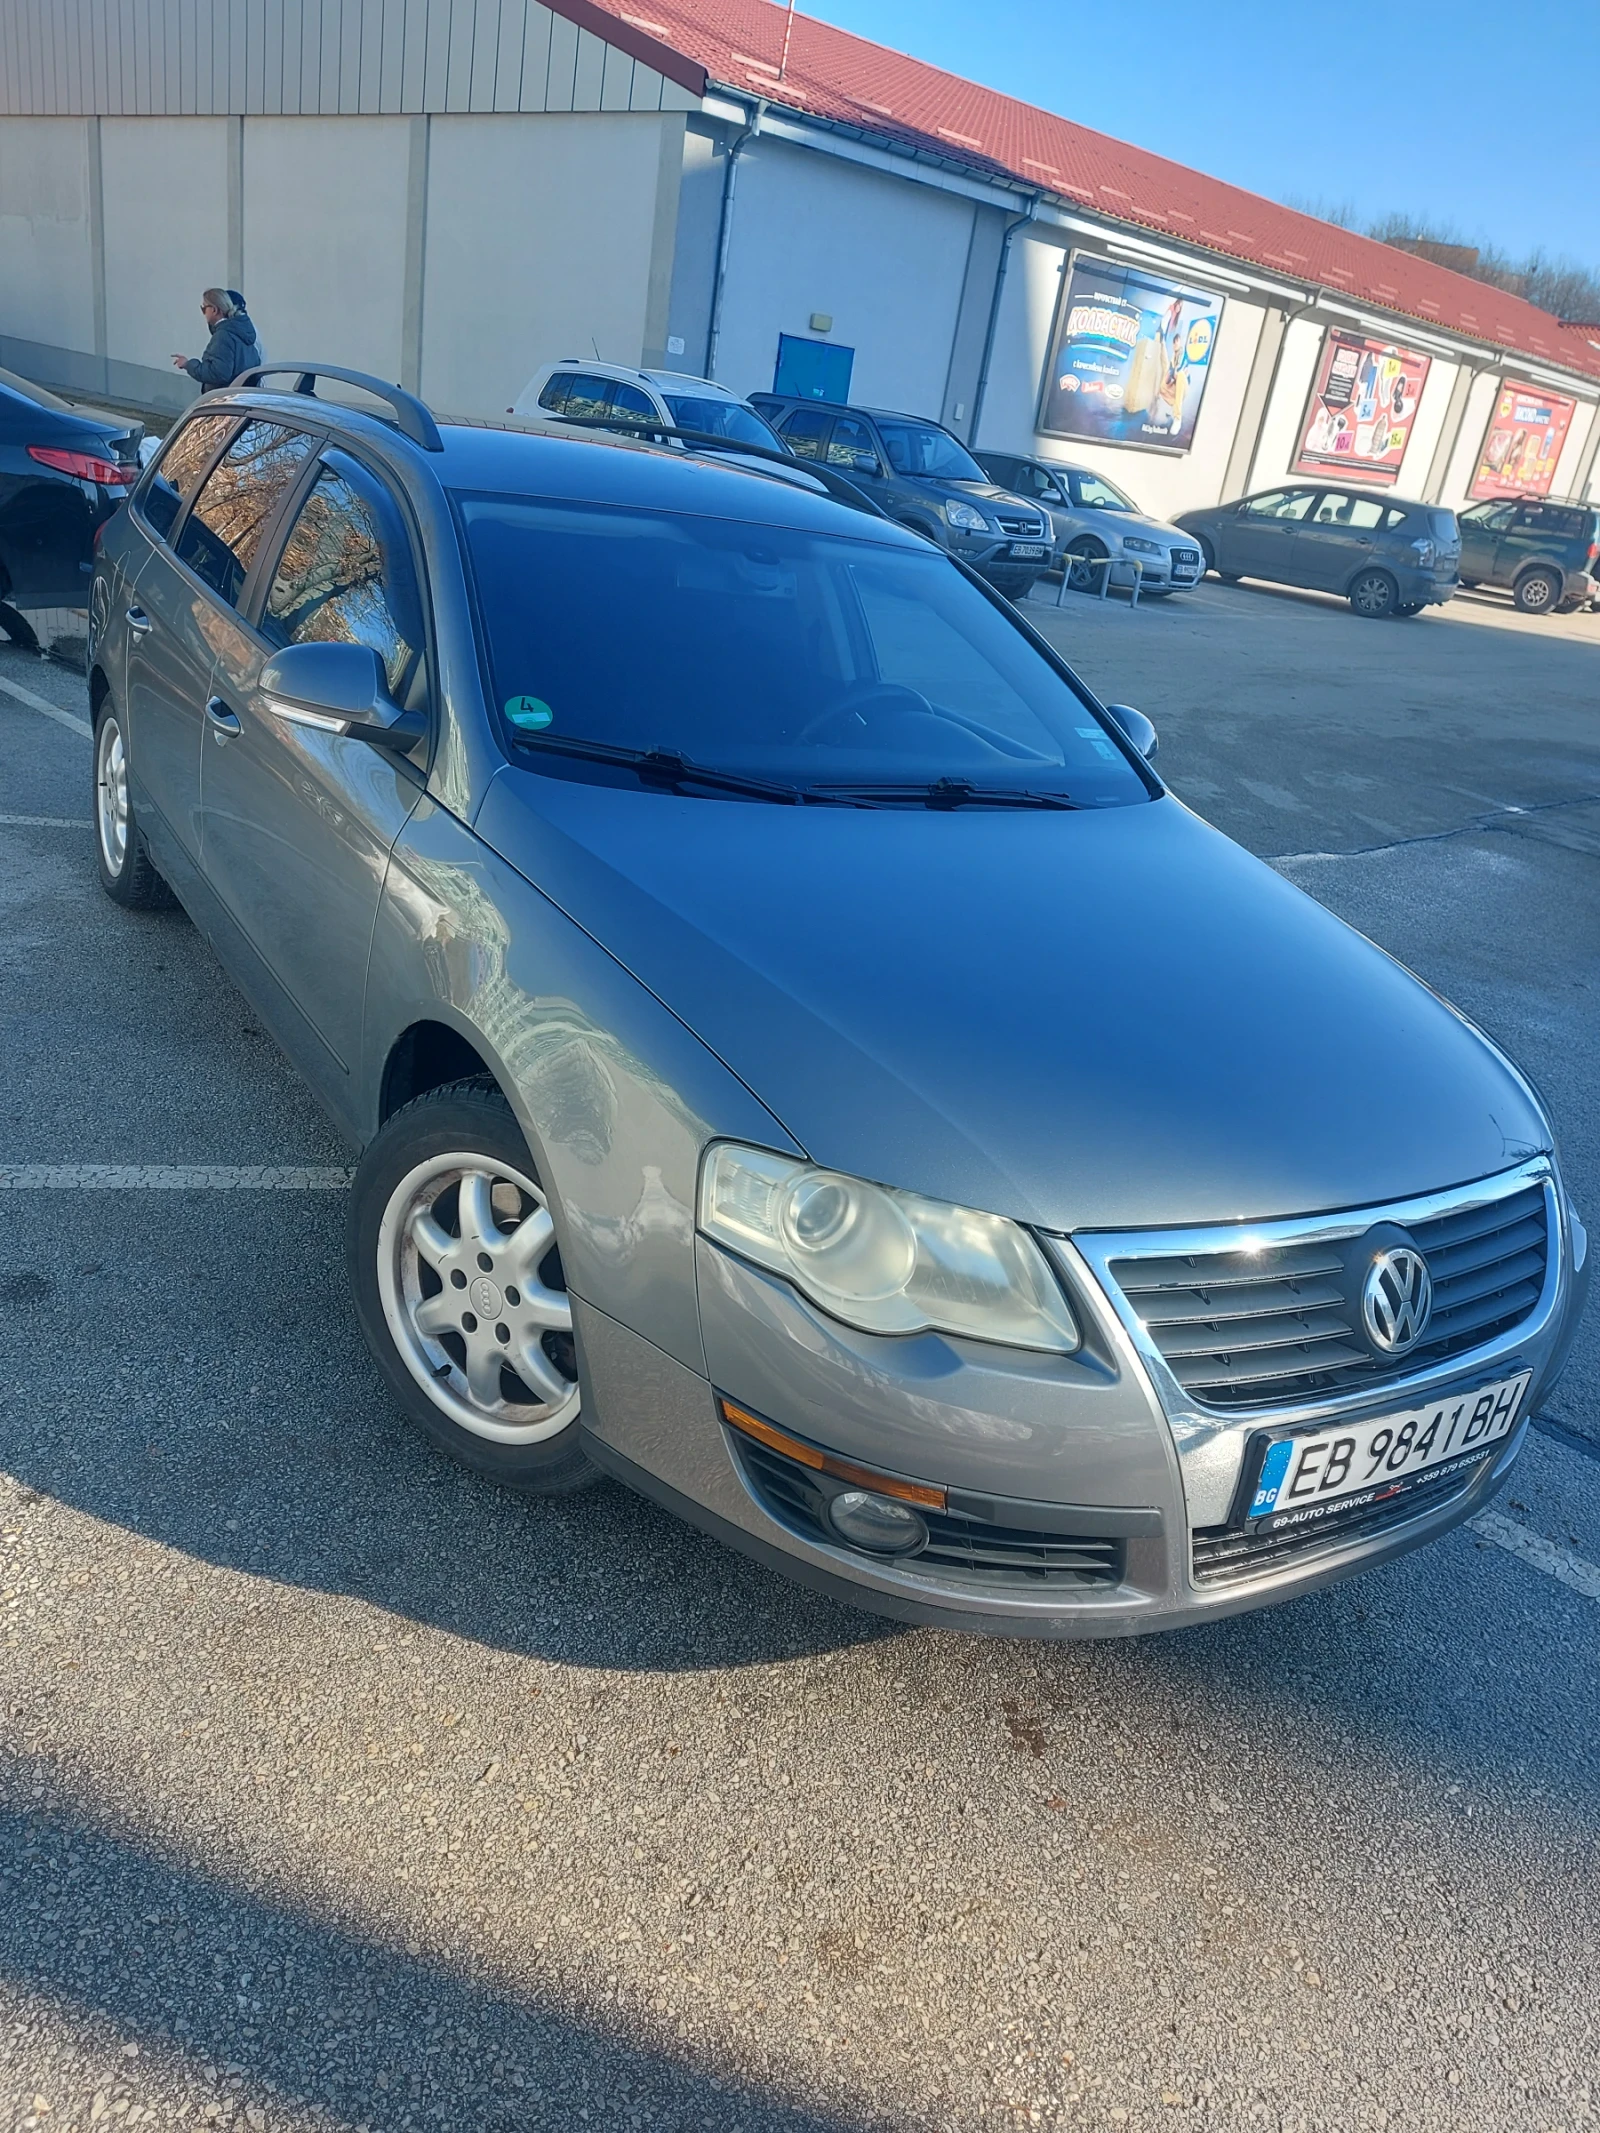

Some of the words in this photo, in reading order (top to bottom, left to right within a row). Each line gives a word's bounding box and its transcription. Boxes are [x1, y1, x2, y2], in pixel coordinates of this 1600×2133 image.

[1068, 308, 1139, 345] КОЛБАСТИК
[520, 697, 535, 712] 4
[1255, 1489, 1278, 1506] BG
[1288, 1437, 1356, 1500] EB
[1362, 1403, 1465, 1481] 9841
[1461, 1381, 1523, 1446] BH
[1272, 1507, 1324, 1529] 69-AUTO
[1326, 1492, 1376, 1514] SERVICE
